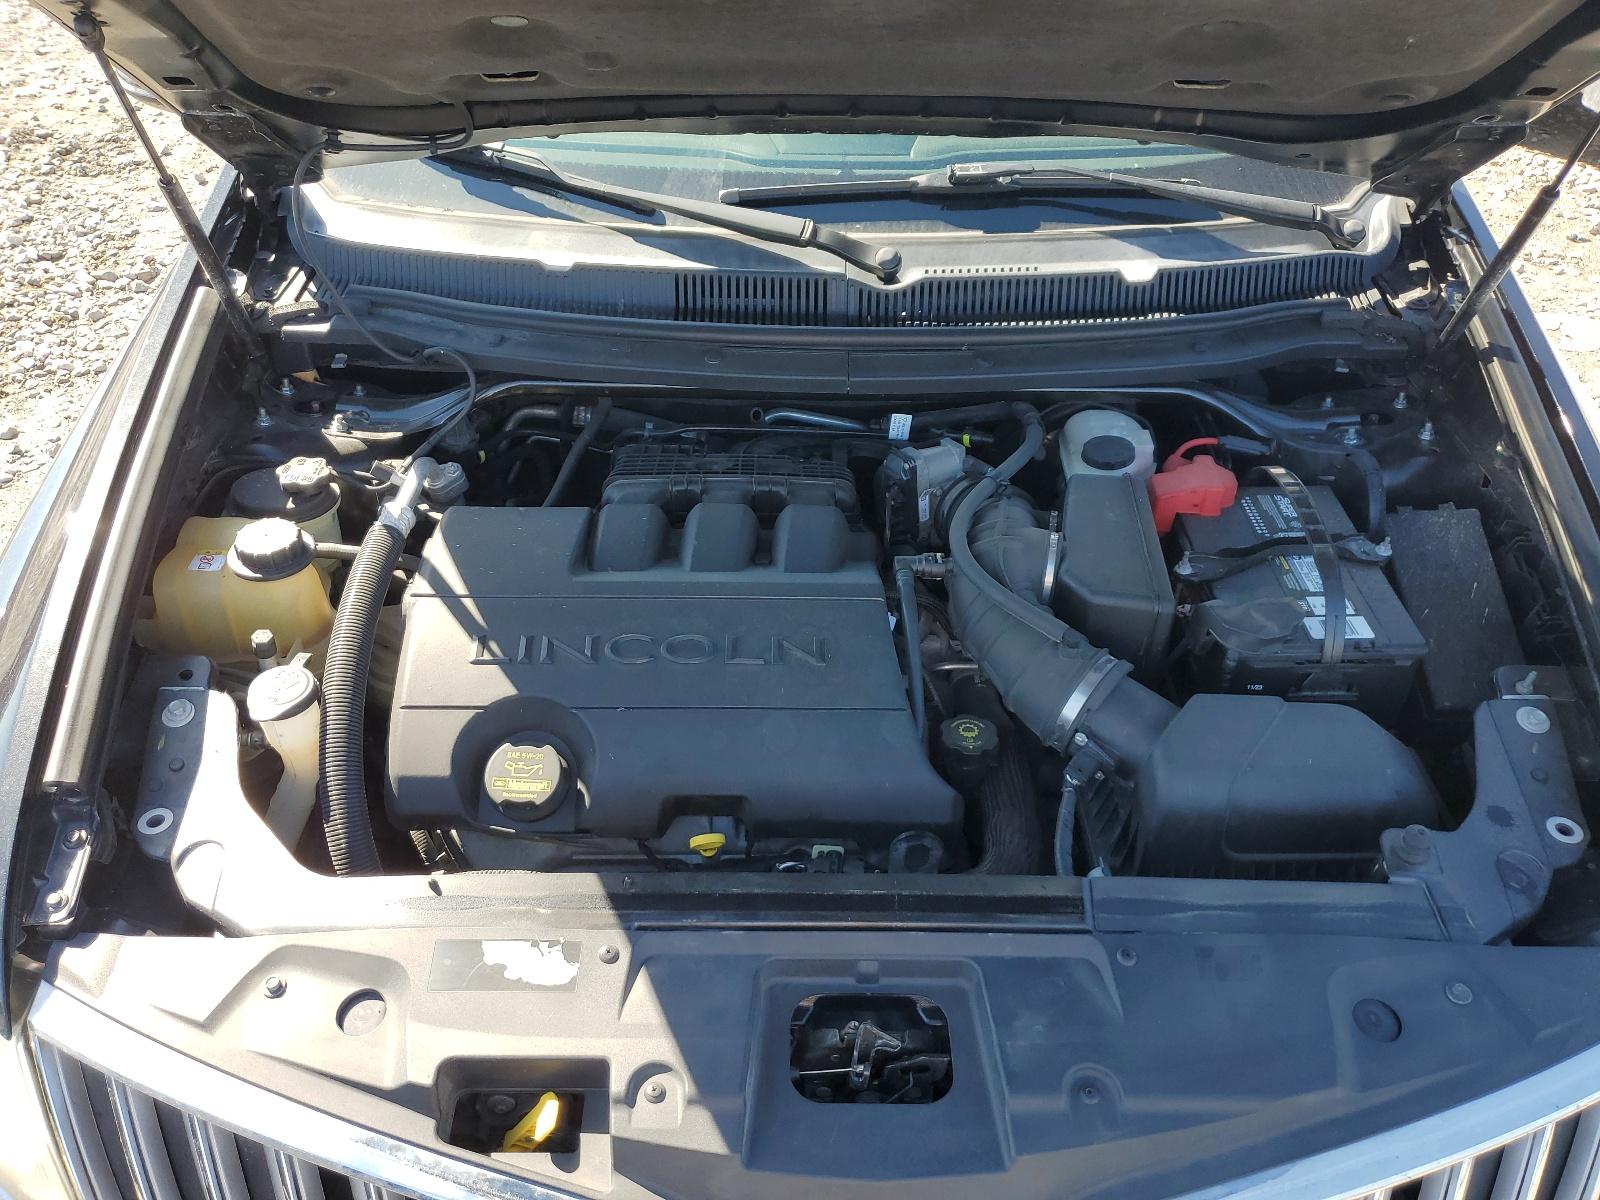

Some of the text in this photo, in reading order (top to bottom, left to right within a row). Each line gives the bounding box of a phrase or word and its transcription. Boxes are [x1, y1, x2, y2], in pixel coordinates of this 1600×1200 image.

[469, 633, 831, 666] LINCOLN
[506, 751, 544, 760] SAE 5W-20
